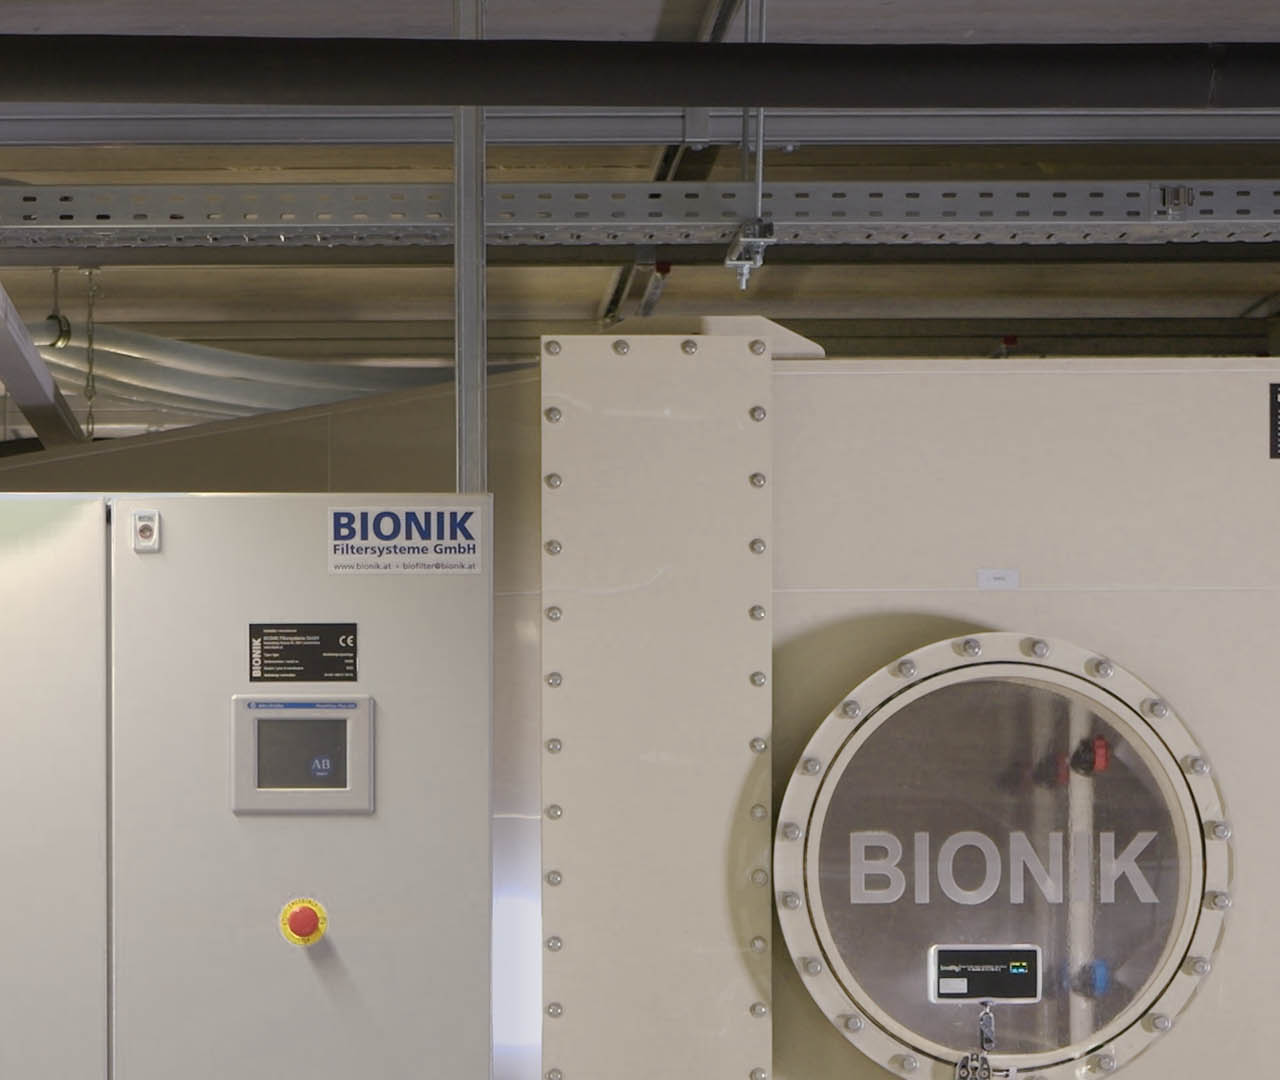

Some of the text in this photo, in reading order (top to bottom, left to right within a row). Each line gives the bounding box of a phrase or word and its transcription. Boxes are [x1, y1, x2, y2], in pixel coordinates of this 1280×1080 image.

[332, 511, 476, 541] BIONIK
[333, 543, 476, 557] Filtersysteme GmbH
[334, 562, 476, 570] www.bionik.at biofilter@bionik.at
[251, 638, 262, 677] BIONIK
[312, 759, 330, 770] AB
[849, 830, 1160, 905] BIONIK
